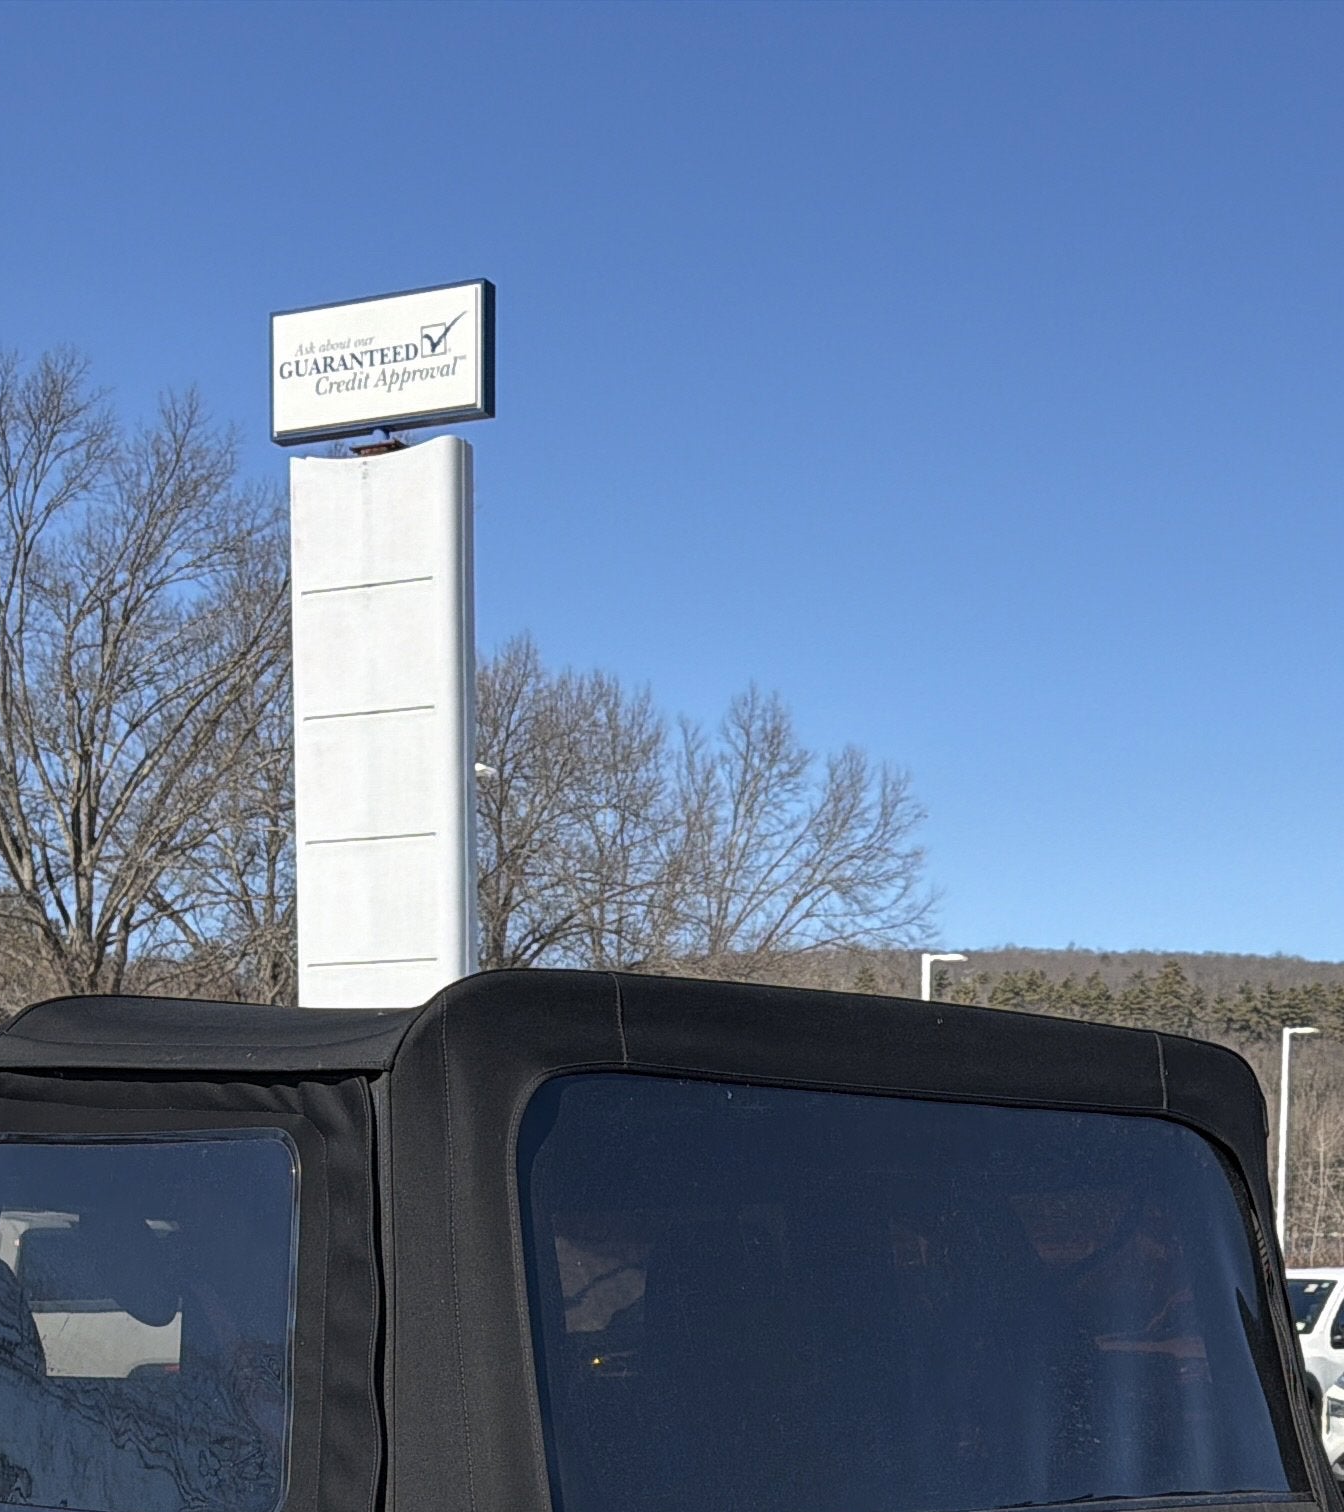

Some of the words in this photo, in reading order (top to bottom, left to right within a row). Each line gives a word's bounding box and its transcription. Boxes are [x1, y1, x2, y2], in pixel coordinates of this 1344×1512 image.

[294, 341, 316, 357] Ask
[318, 337, 352, 353] about
[353, 335, 375, 348] our
[279, 342, 419, 379] GUARANTEED
[315, 372, 369, 396] Credit
